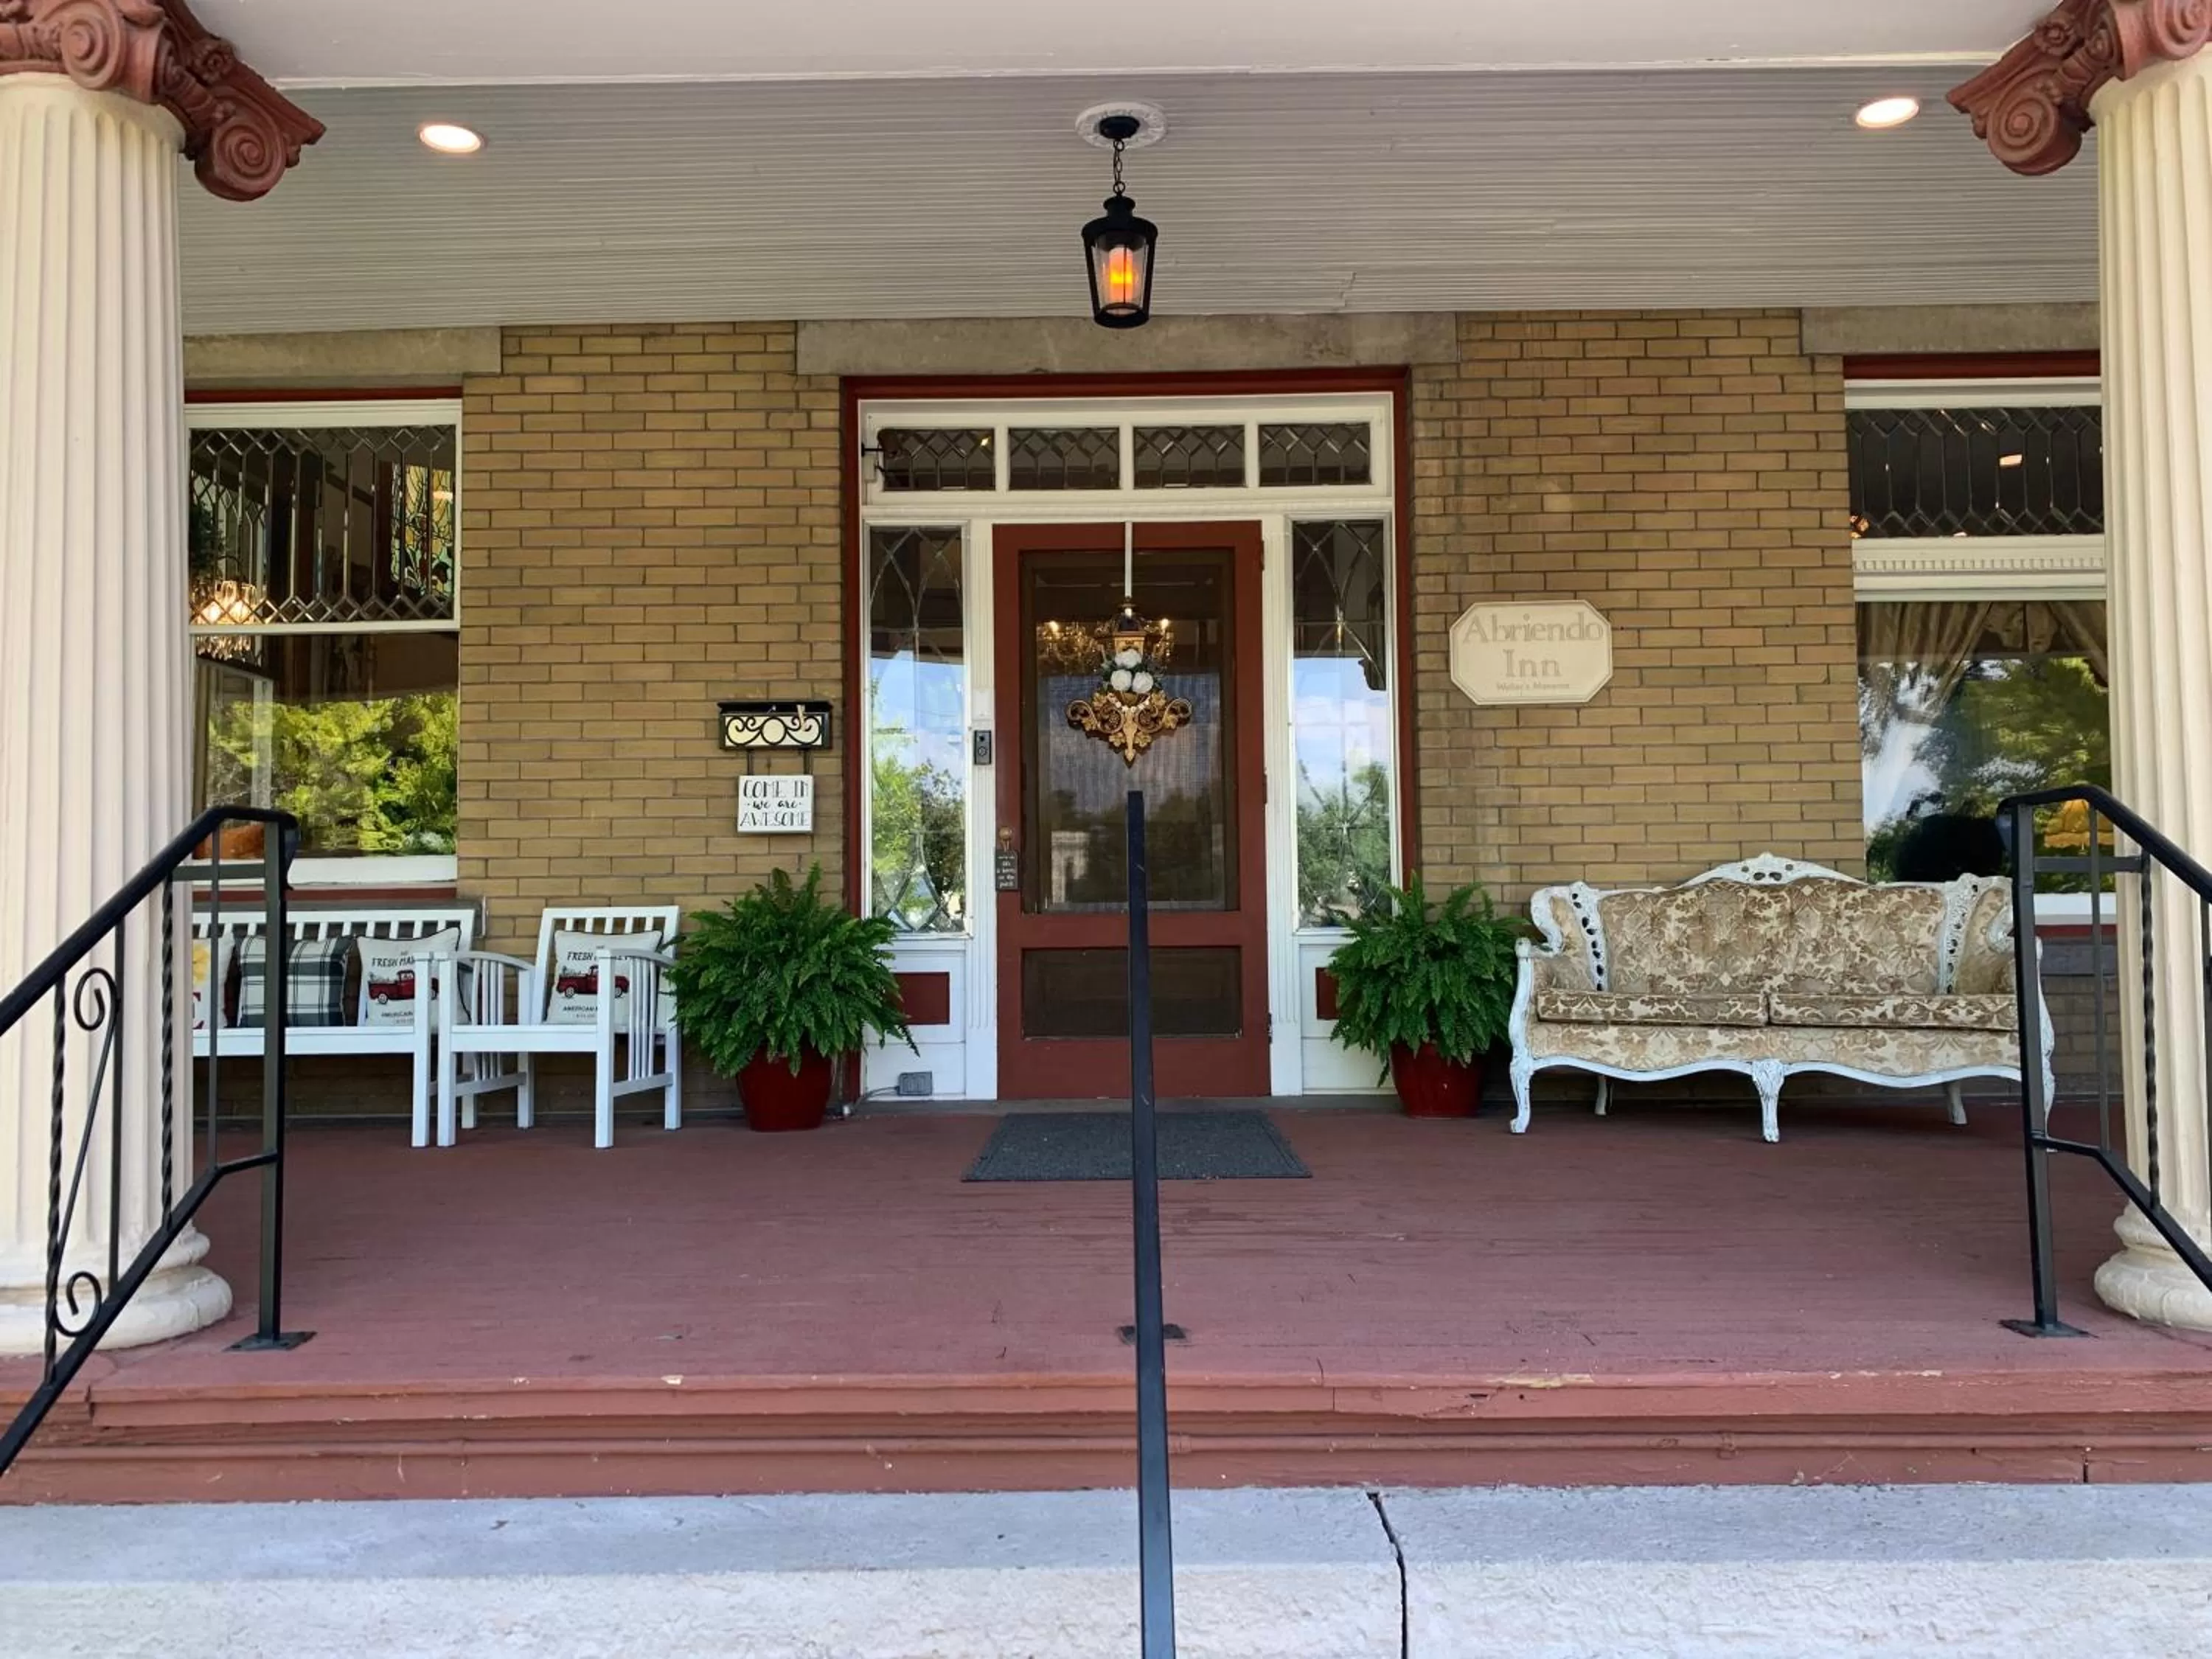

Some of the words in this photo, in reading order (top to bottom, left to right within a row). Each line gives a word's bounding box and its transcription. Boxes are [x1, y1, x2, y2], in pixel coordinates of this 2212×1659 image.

[1463, 612, 1604, 644] Abriendo
[1503, 648, 1562, 678] Inn
[743, 779, 787, 798] COME
[794, 779, 810, 798] IN
[753, 800, 771, 810] we
[778, 800, 798, 809] are
[740, 812, 810, 827] AWESOME
[372, 957, 397, 968] FRESH
[566, 951, 593, 961] FRESH
